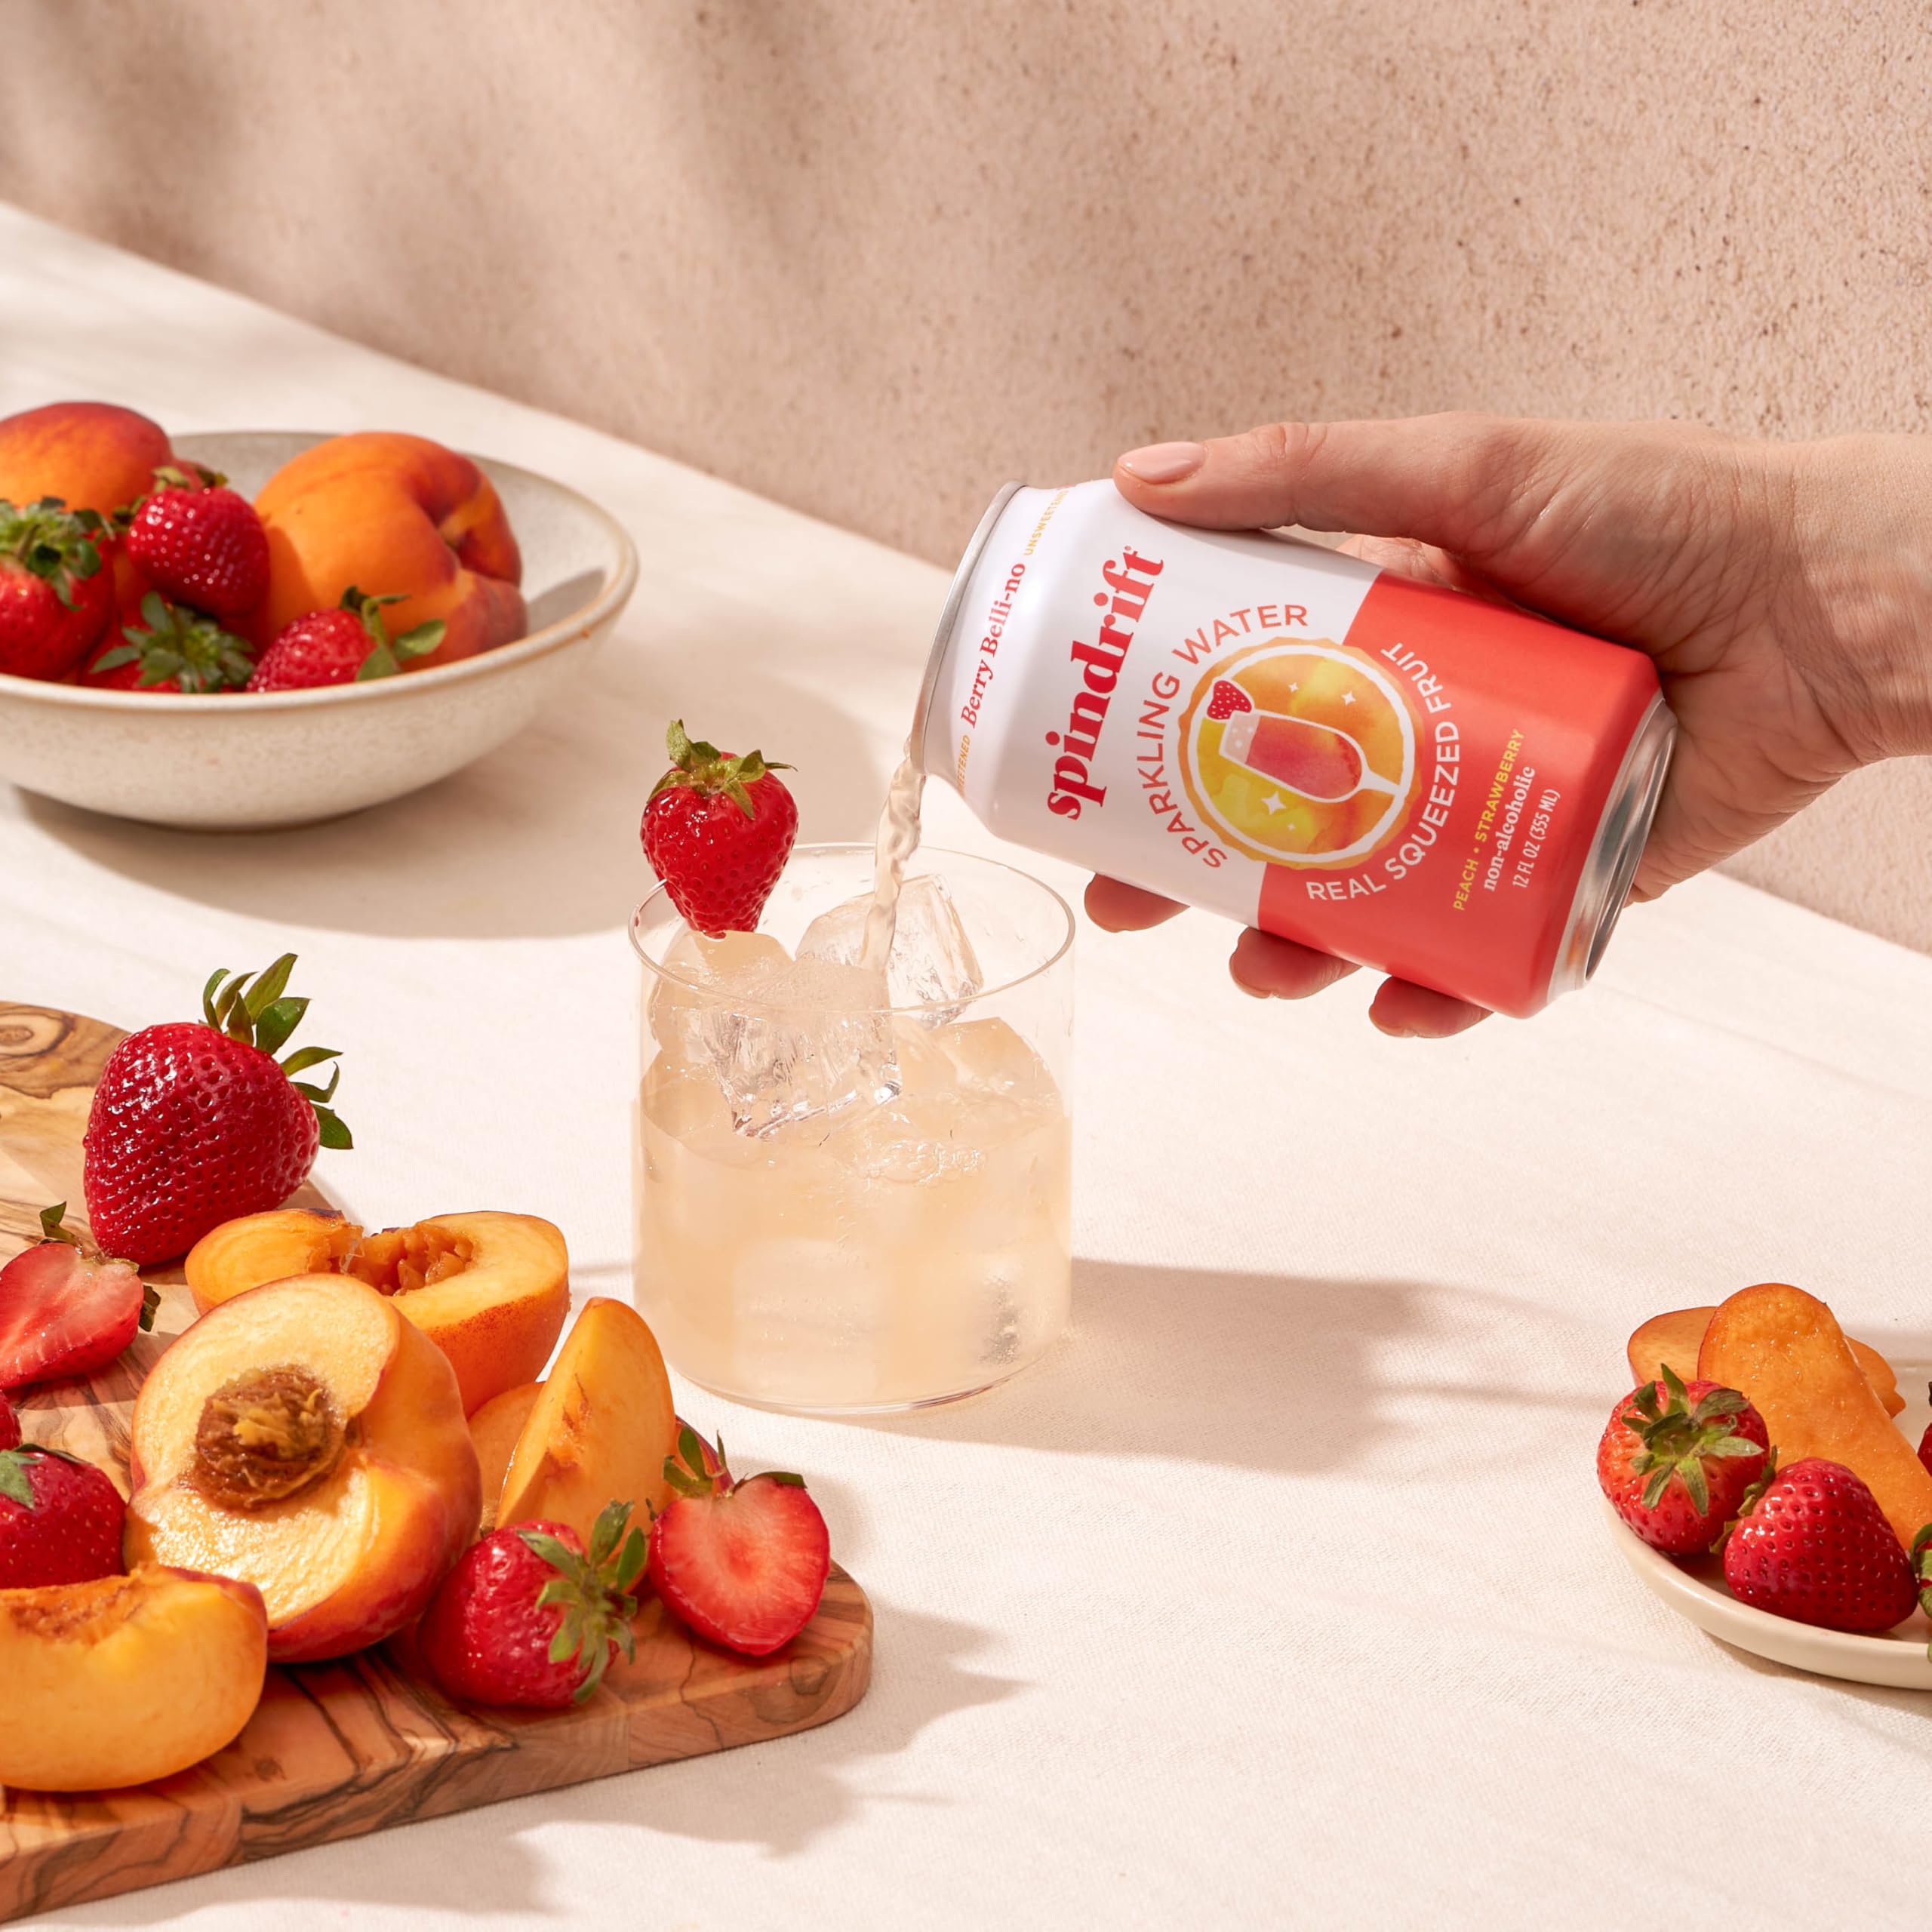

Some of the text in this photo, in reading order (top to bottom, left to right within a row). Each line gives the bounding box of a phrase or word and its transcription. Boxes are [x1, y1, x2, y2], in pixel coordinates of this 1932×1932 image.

[961, 563, 1026, 728] Berry Belli-no
[1045, 550, 1164, 820] spindrift
[1136, 605, 1309, 868] SPARKLING WATER
[1306, 643, 1460, 900] REAL SQUEEZED FRUIT
[1453, 728, 1525, 911] PEACH STRAWBERRY
[1484, 766, 1536, 892] non-alcoholic
[1512, 789, 1561, 888] 12 FL OZ (355 ML)
